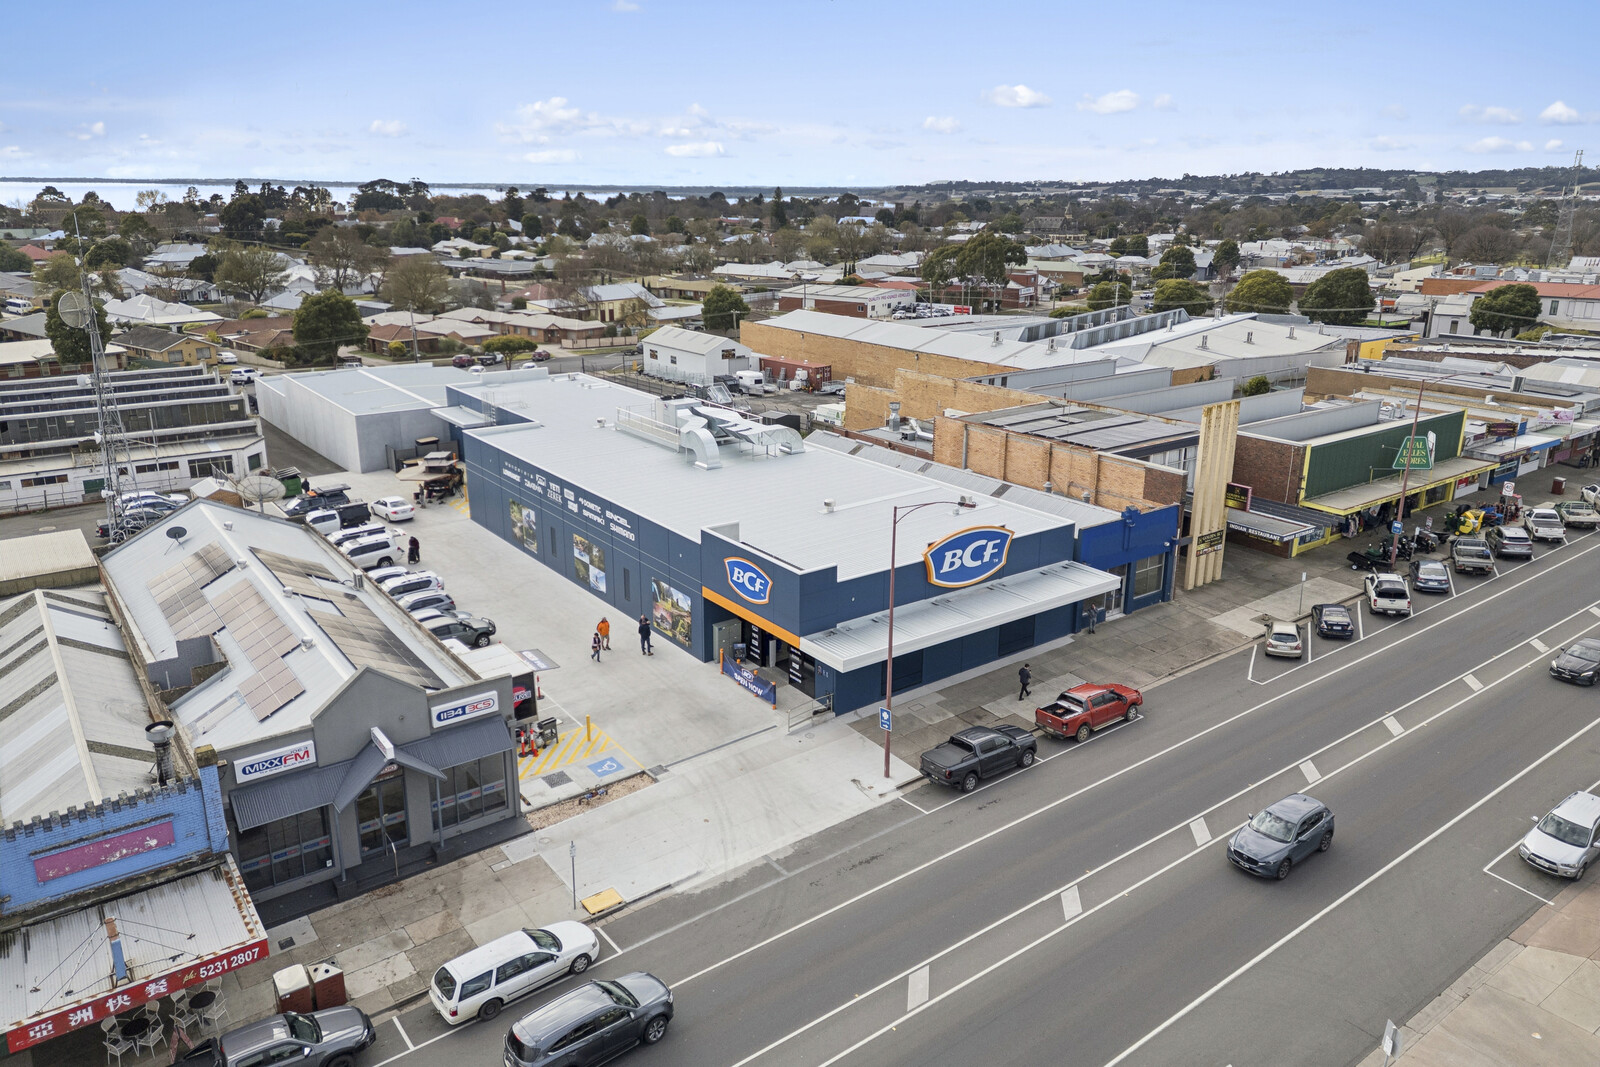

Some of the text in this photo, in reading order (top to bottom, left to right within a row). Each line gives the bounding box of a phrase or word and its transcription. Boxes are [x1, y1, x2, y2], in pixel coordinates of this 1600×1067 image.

[609, 522, 635, 542] SHIMANO
[1229, 523, 1247, 533] INDIAN
[1248, 528, 1280, 541] RESTAURANT
[940, 539, 1000, 573] BCF
[732, 566, 765, 592] BCF
[748, 682, 763, 696] NOW
[440, 700, 491, 720] 1134 3CS
[245, 749, 310, 775] MIXX FM
[200, 959, 229, 978] 5231
[230, 947, 260, 968] 2807
